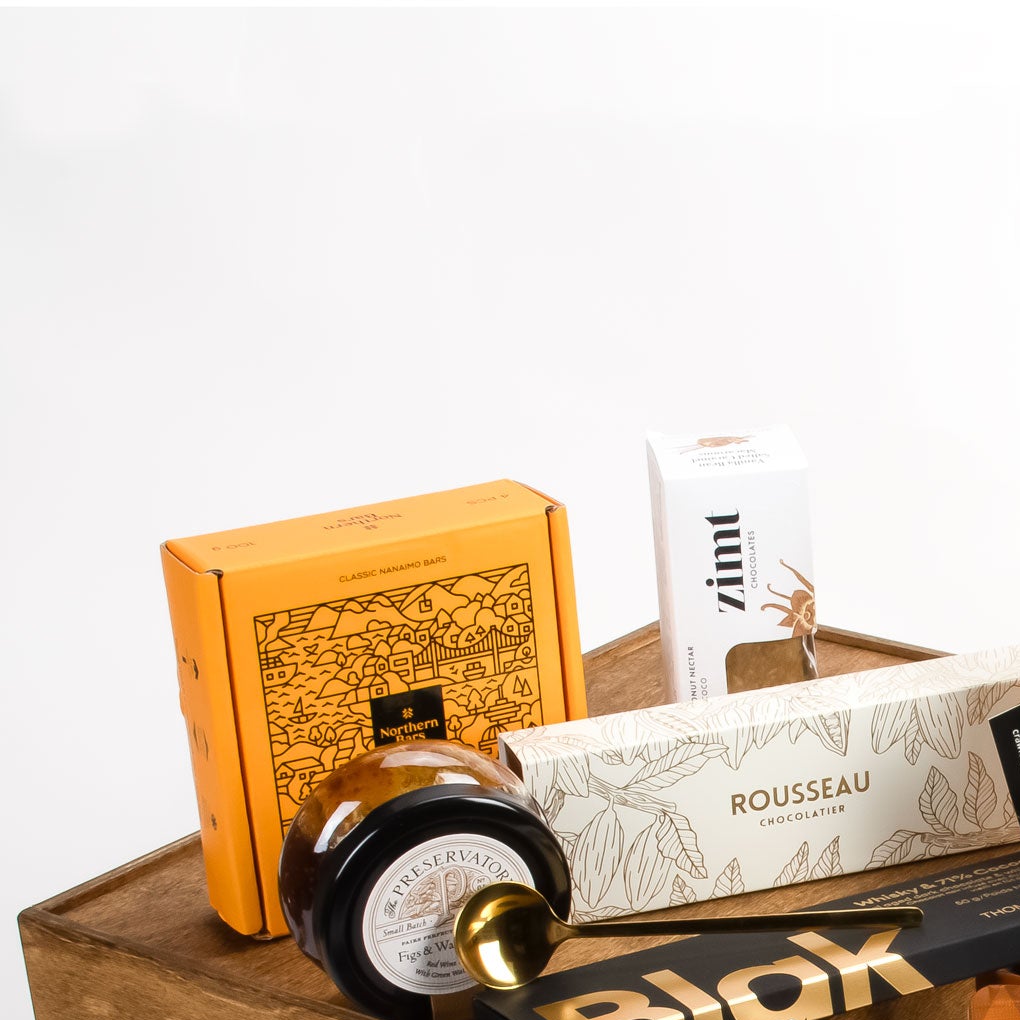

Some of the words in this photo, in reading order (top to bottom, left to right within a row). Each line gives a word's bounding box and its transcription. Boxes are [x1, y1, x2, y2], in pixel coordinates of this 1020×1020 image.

[339, 570, 377, 583] CLASSIC
[379, 561, 421, 576] NANAIMO
[423, 555, 447, 567] BARS
[704, 508, 746, 613] zimt
[747, 530, 759, 589] CHOCOLATES
[687, 646, 695, 678] NECTAR
[690, 681, 698, 701] ONUT
[380, 717, 439, 739] Northern
[730, 770, 871, 817] ROUSSEAU
[760, 804, 846, 827] CHOCOLATIER
[392, 849, 514, 897] PRESERVATOR
[853, 886, 919, 908] Whisky
[920, 882, 937, 891] &
[383, 926, 404, 938] Small
[406, 919, 427, 932] Batch
[398, 950, 421, 963] Figs
[424, 946, 433, 956] &
